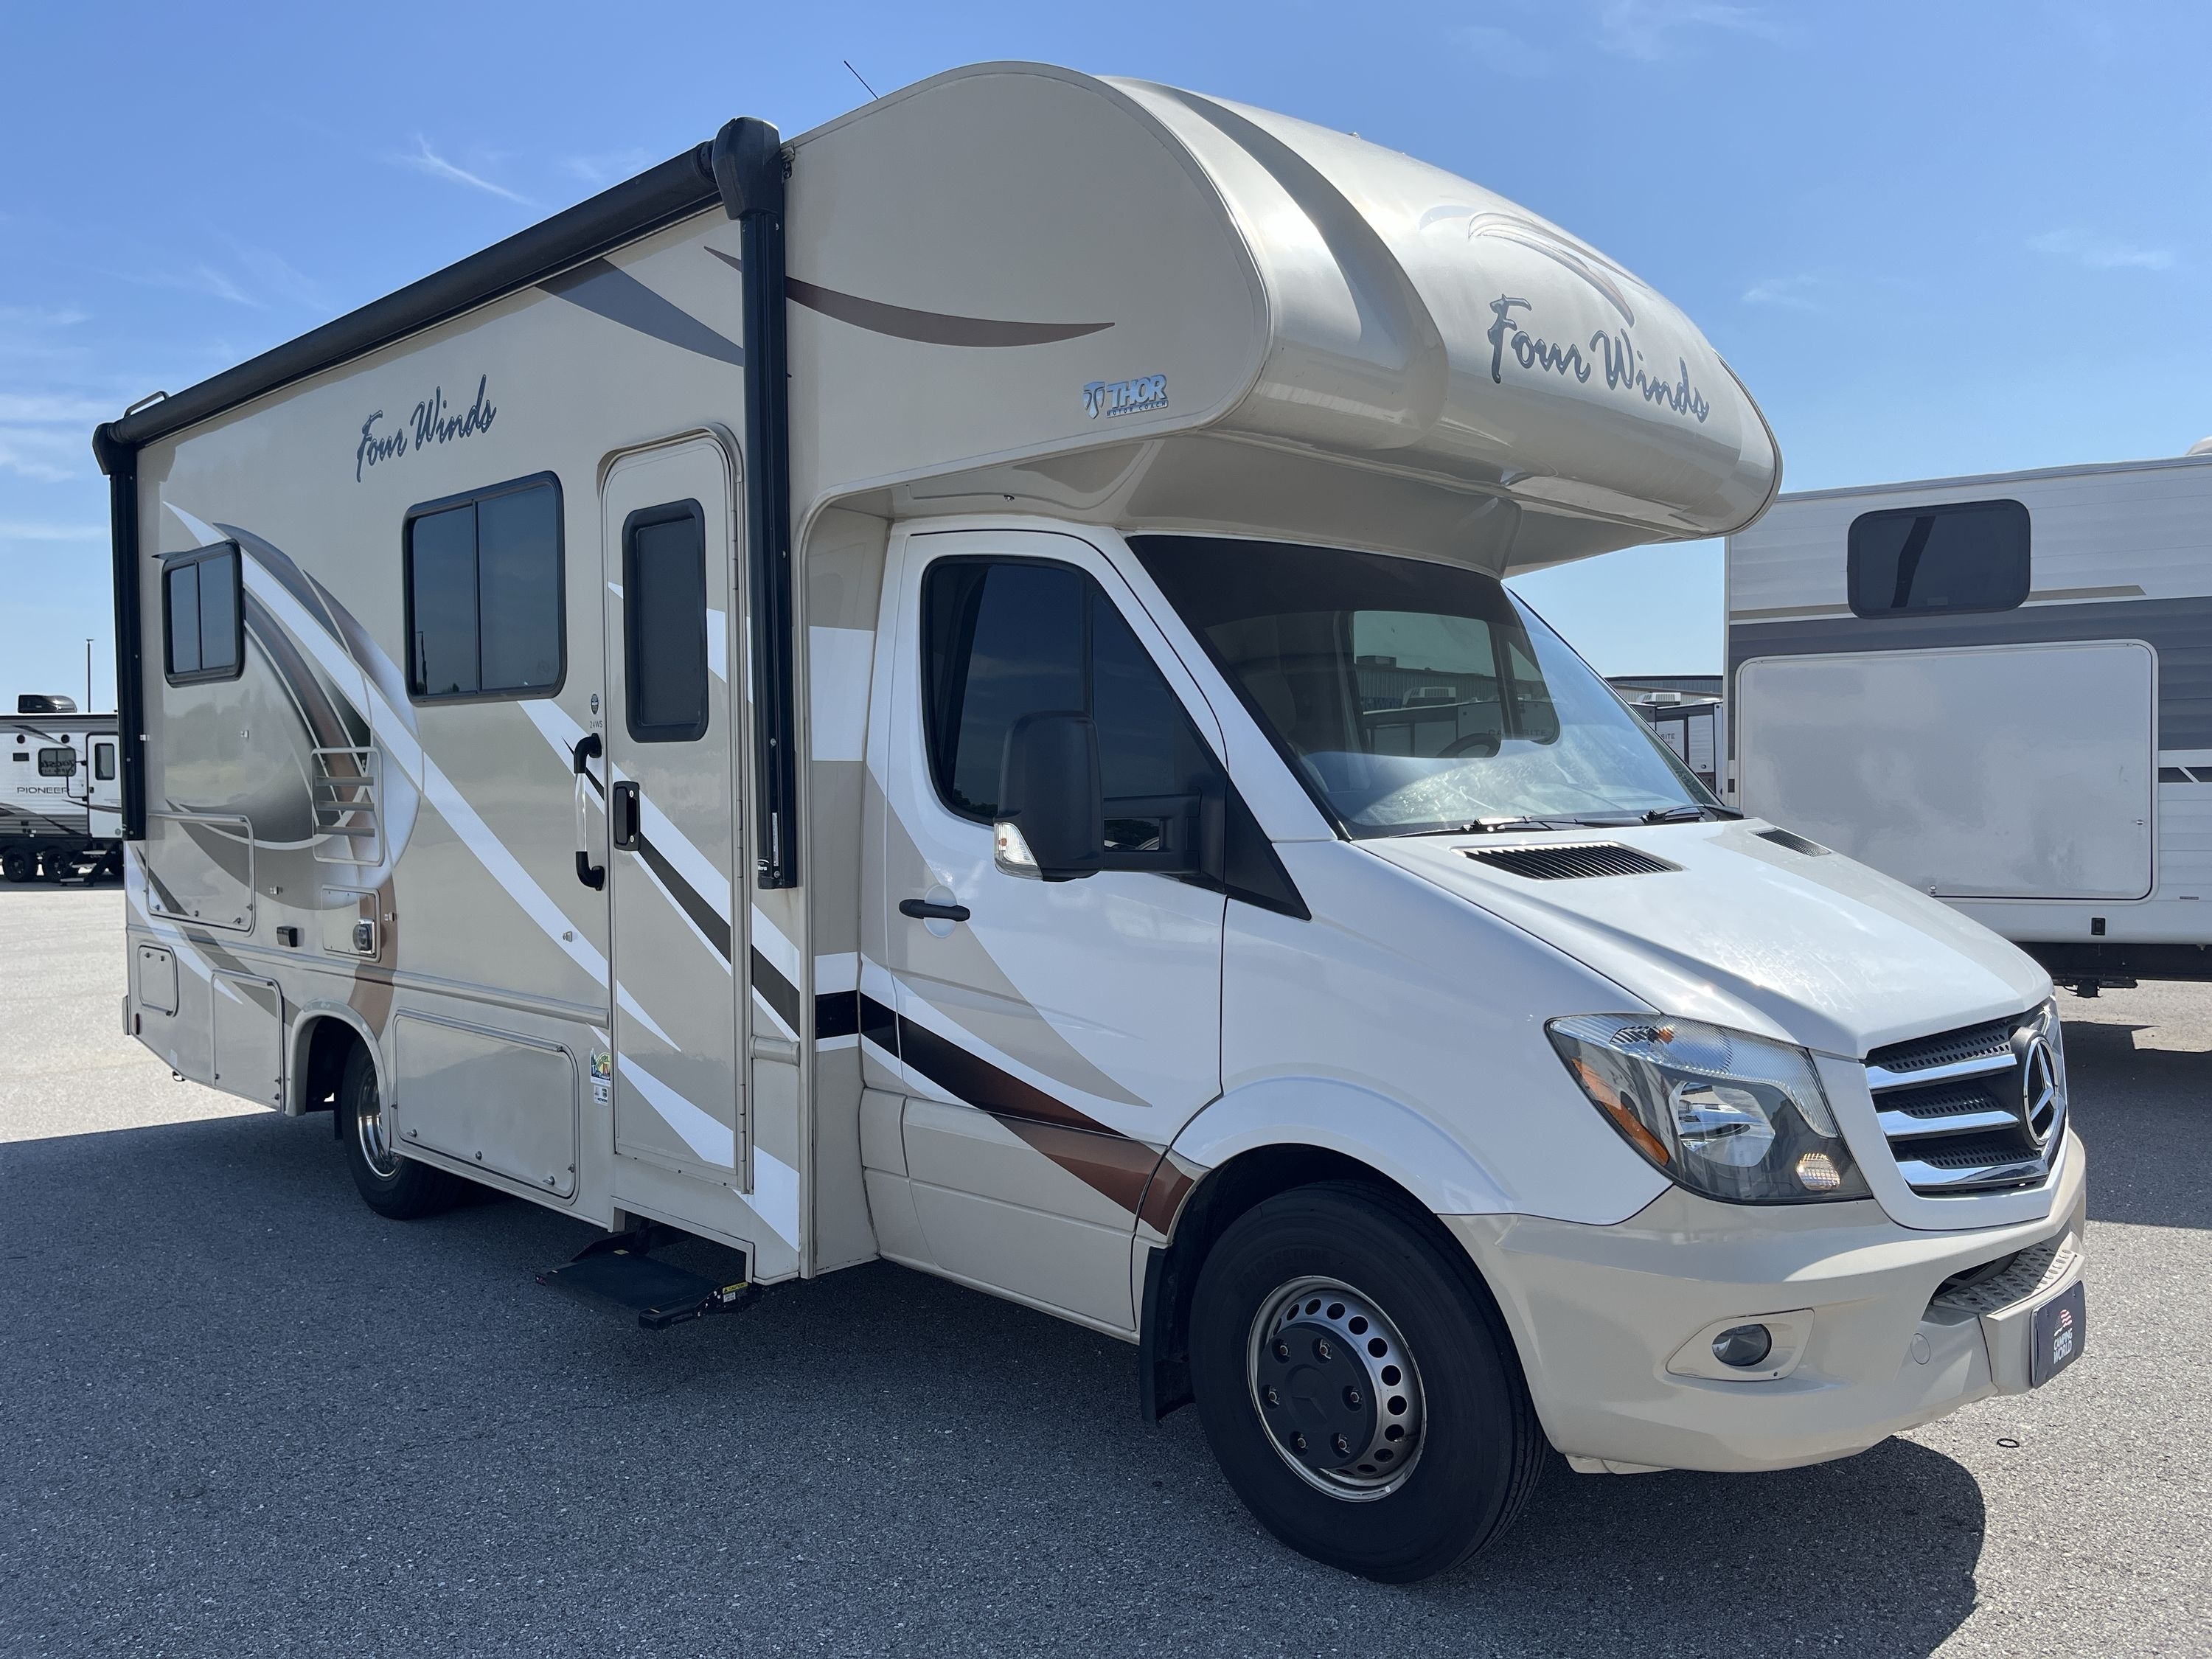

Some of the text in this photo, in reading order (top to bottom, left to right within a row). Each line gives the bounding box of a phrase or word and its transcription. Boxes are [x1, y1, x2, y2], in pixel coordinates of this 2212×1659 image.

[1487, 293, 1710, 423] Four Winds
[1106, 374, 1168, 409] THOR
[1107, 400, 1166, 416] MOTOR COACH
[356, 374, 497, 483] Four Winds
[590, 720, 603, 728] 24WS
[2053, 1328, 2073, 1351] CAMPING
[2053, 1340, 2072, 1364] WORLD
